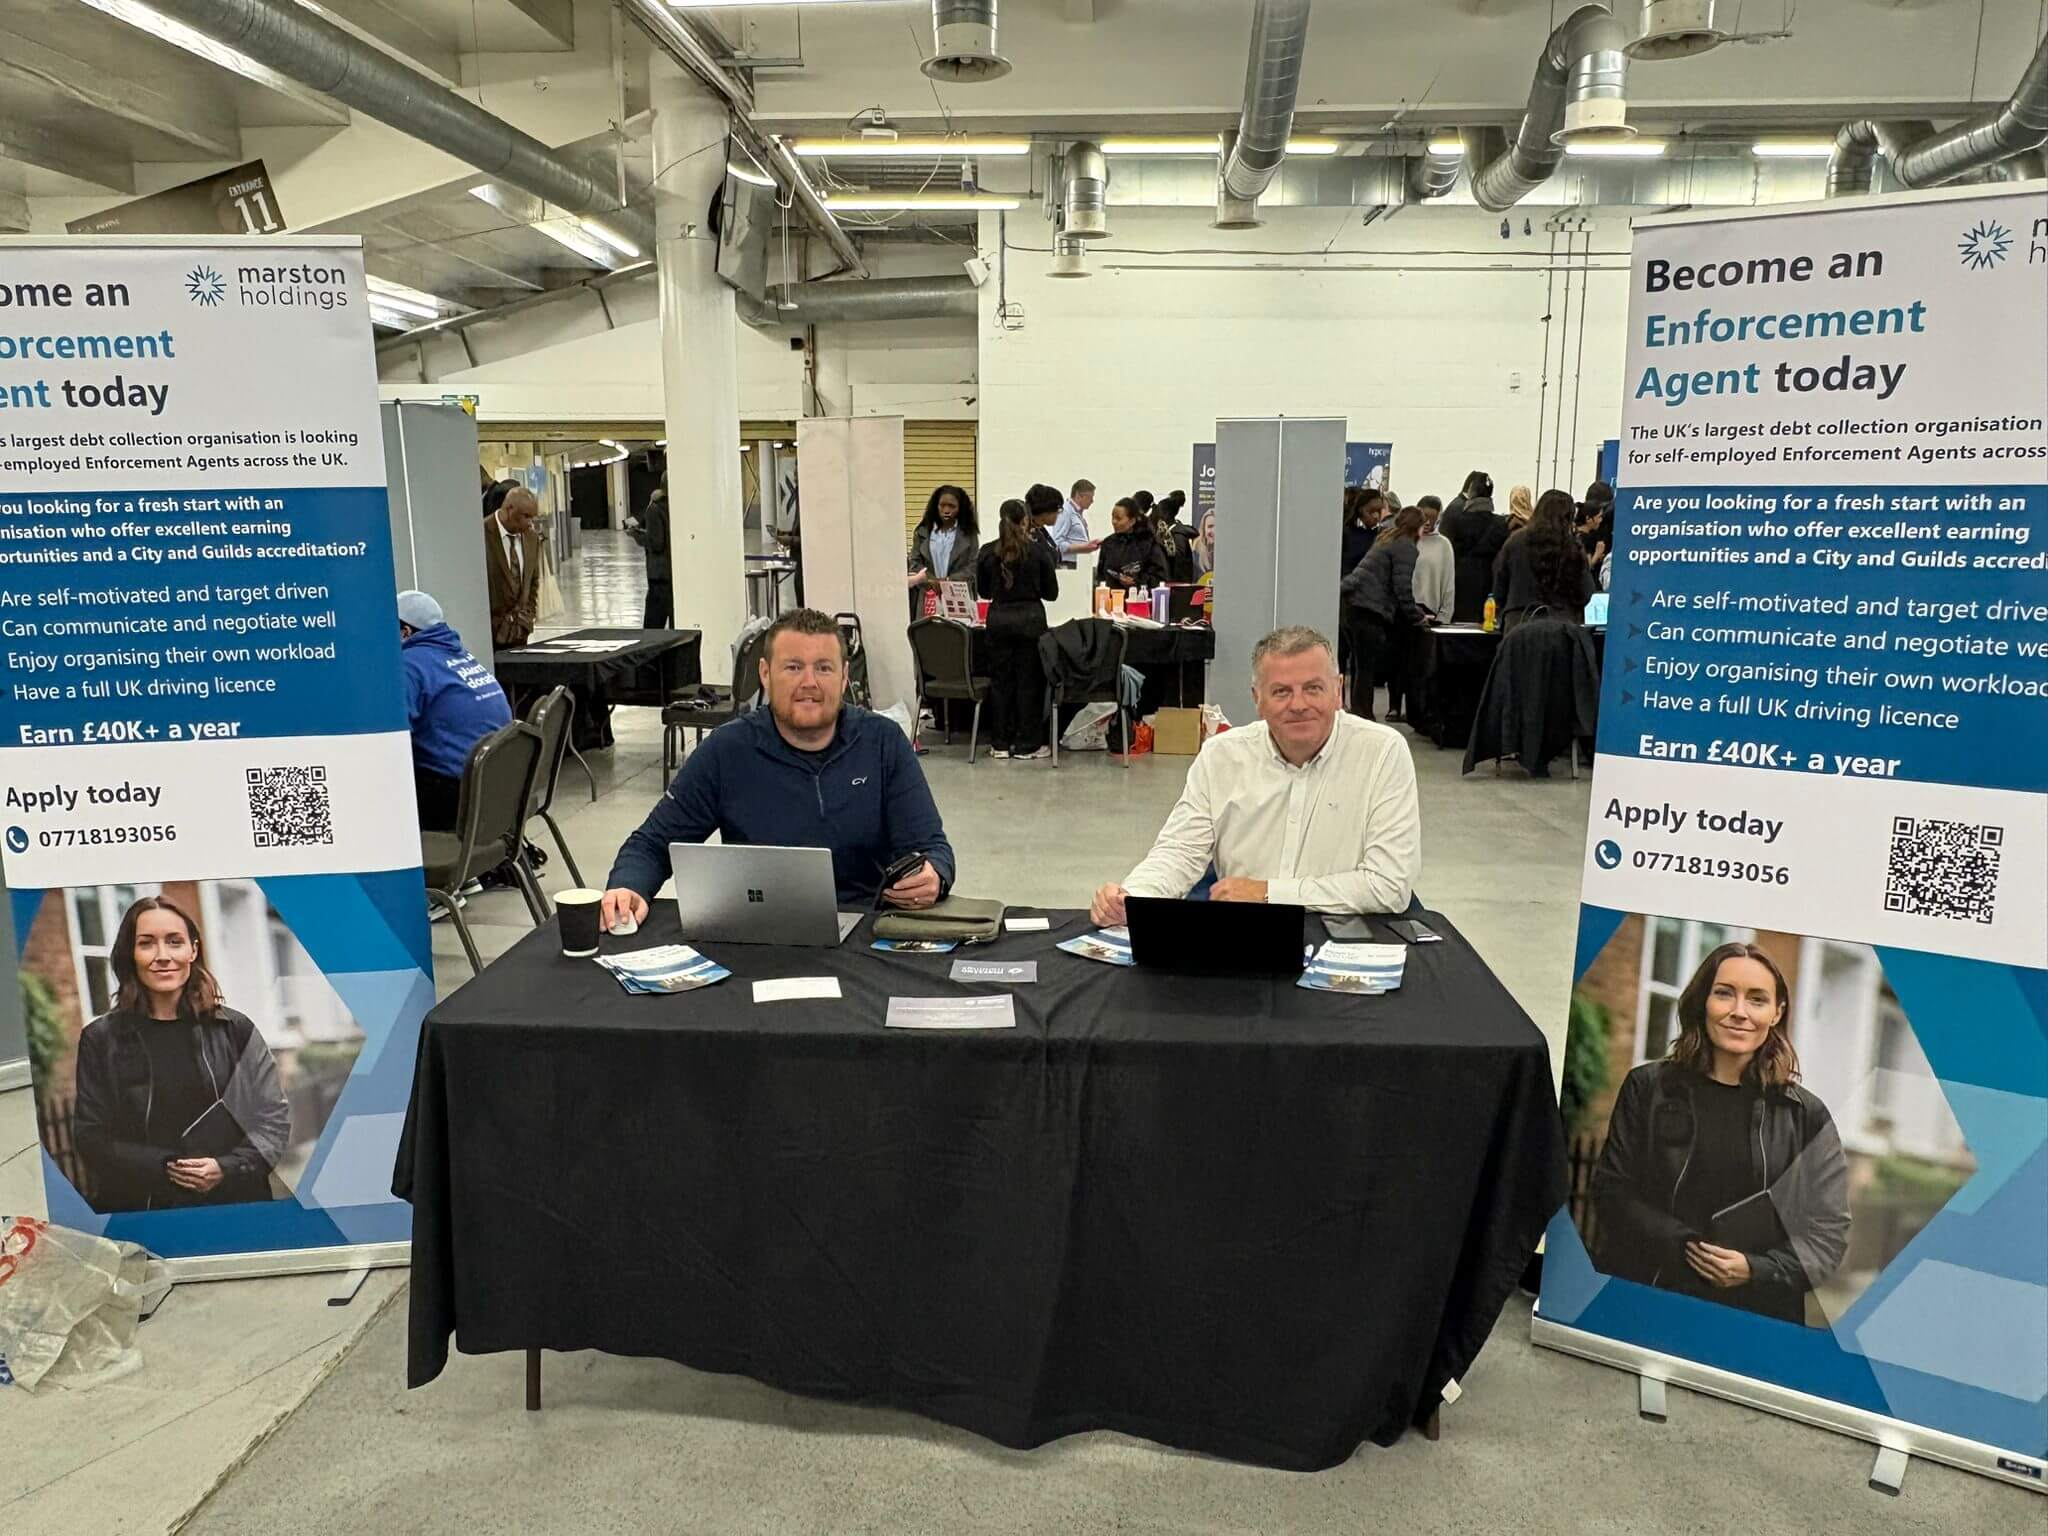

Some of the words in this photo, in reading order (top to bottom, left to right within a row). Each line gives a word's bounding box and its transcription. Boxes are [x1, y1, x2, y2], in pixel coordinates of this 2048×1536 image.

[234, 191, 278, 235] 11
[237, 263, 346, 285] marston
[1645, 256, 1814, 293] Become
[1827, 250, 1883, 280] an
[85, 283, 130, 307] an
[239, 284, 348, 311] holdings
[1645, 300, 1927, 348] Enforcement
[1634, 363, 1761, 407] Agent
[1774, 354, 1907, 401] today
[61, 374, 169, 416] today
[10, 433, 66, 451] largest
[69, 432, 105, 447] debt
[108, 431, 183, 446] collection
[187, 430, 281, 449] organisation
[285, 433, 297, 444] is
[300, 429, 358, 447] looking
[1630, 425, 1659, 441] The
[1704, 422, 1765, 441] largest
[1769, 420, 1812, 436] debt
[1816, 418, 1908, 435] collection
[1914, 415, 2042, 437] organisation
[85, 455, 183, 470] Enforcement
[186, 454, 240, 472] Agents
[243, 456, 289, 467] across
[292, 452, 317, 466] the
[321, 452, 348, 466] UK.
[1628, 449, 1652, 465] for
[1654, 446, 1777, 466] self-employed
[1782, 445, 1902, 462] Enforcement
[1906, 445, 1977, 464] Agents
[1982, 446, 2047, 459] across
[1, 503, 23, 515] ou
[27, 499, 91, 518] looking
[94, 498, 121, 513] for
[124, 501, 134, 513] a
[137, 497, 179, 513] fresh
[183, 498, 222, 512] start
[224, 495, 261, 511] with
[264, 499, 284, 510] an
[1632, 495, 1663, 510] Are
[1666, 498, 1700, 514] you
[1705, 493, 1777, 514] looking
[1782, 493, 1813, 510] for
[1816, 498, 1828, 510] a
[1834, 493, 1885, 511] fresh
[1890, 495, 1940, 511] start
[1945, 493, 1993, 511] with
[1998, 498, 2026, 511] an
[0, 524, 67, 540] nisation
[70, 523, 106, 538] who
[110, 521, 151, 537] offer
[155, 520, 228, 537] excellent
[231, 519, 292, 538] earning
[1630, 520, 1742, 540] organisation
[1747, 520, 1789, 537] who
[1793, 520, 1844, 538] offer
[1847, 521, 1942, 539] excellent
[1946, 526, 2030, 545] earning
[82, 546, 114, 562] and
[117, 550, 128, 562] a
[131, 546, 163, 564] City
[167, 544, 198, 560] and
[201, 543, 253, 560] Guilds
[256, 541, 367, 558] accreditation?
[1628, 547, 1749, 566] opportunities
[1753, 547, 1791, 564] and
[1795, 552, 1807, 565] a
[1812, 549, 1852, 570] City
[1856, 549, 1896, 567] and
[1901, 550, 1967, 568] Guilds
[0, 590, 32, 607] Are
[37, 585, 171, 606] self-motivated
[176, 584, 210, 603] and
[215, 585, 271, 605] target
[274, 582, 329, 600] driven
[1651, 589, 1687, 609] Are
[1692, 590, 1849, 615] self-motivated
[1855, 596, 1900, 617] and
[1906, 599, 1979, 624] target
[2, 619, 38, 637] Can
[43, 616, 168, 636] communicate
[173, 613, 207, 632] and
[212, 612, 298, 635] negotiate
[301, 610, 336, 628] well
[1647, 621, 1685, 641] Can
[1691, 626, 1837, 648] communicate
[1843, 630, 1887, 650] and
[1894, 634, 2009, 658] negotiate
[7, 650, 58, 673] Enjoy
[63, 647, 161, 671] organising
[165, 646, 208, 664] their
[212, 648, 251, 663] own
[255, 642, 336, 661] workload
[1645, 656, 1701, 681] Enjoy
[1705, 662, 1818, 688] organising
[1825, 665, 1879, 687] their
[1884, 673, 1933, 690] own
[13, 684, 60, 700] Have
[66, 686, 77, 699] a
[81, 680, 111, 698] full
[115, 679, 143, 697] UK
[147, 677, 210, 699] driving
[214, 676, 276, 693] licence
[1643, 690, 1694, 711] Have
[1699, 698, 1711, 712] a
[1718, 694, 1751, 715] full
[1758, 697, 1789, 717] UK
[1794, 699, 1871, 728] driving
[1879, 704, 1959, 729] licence
[19, 724, 74, 745] Earn
[82, 720, 160, 742] £40K+
[168, 724, 183, 739] a
[189, 719, 241, 741] year
[1639, 734, 1698, 760] Earn
[1706, 739, 1797, 767] £40K+
[1807, 753, 1825, 770] a
[1834, 753, 1901, 777] year
[6, 784, 79, 813] Apply
[86, 781, 162, 808] today
[1604, 798, 1688, 834] Apply
[1696, 809, 1784, 844] today
[39, 825, 177, 847] 07718193056
[1632, 850, 1789, 885] 07718193056
